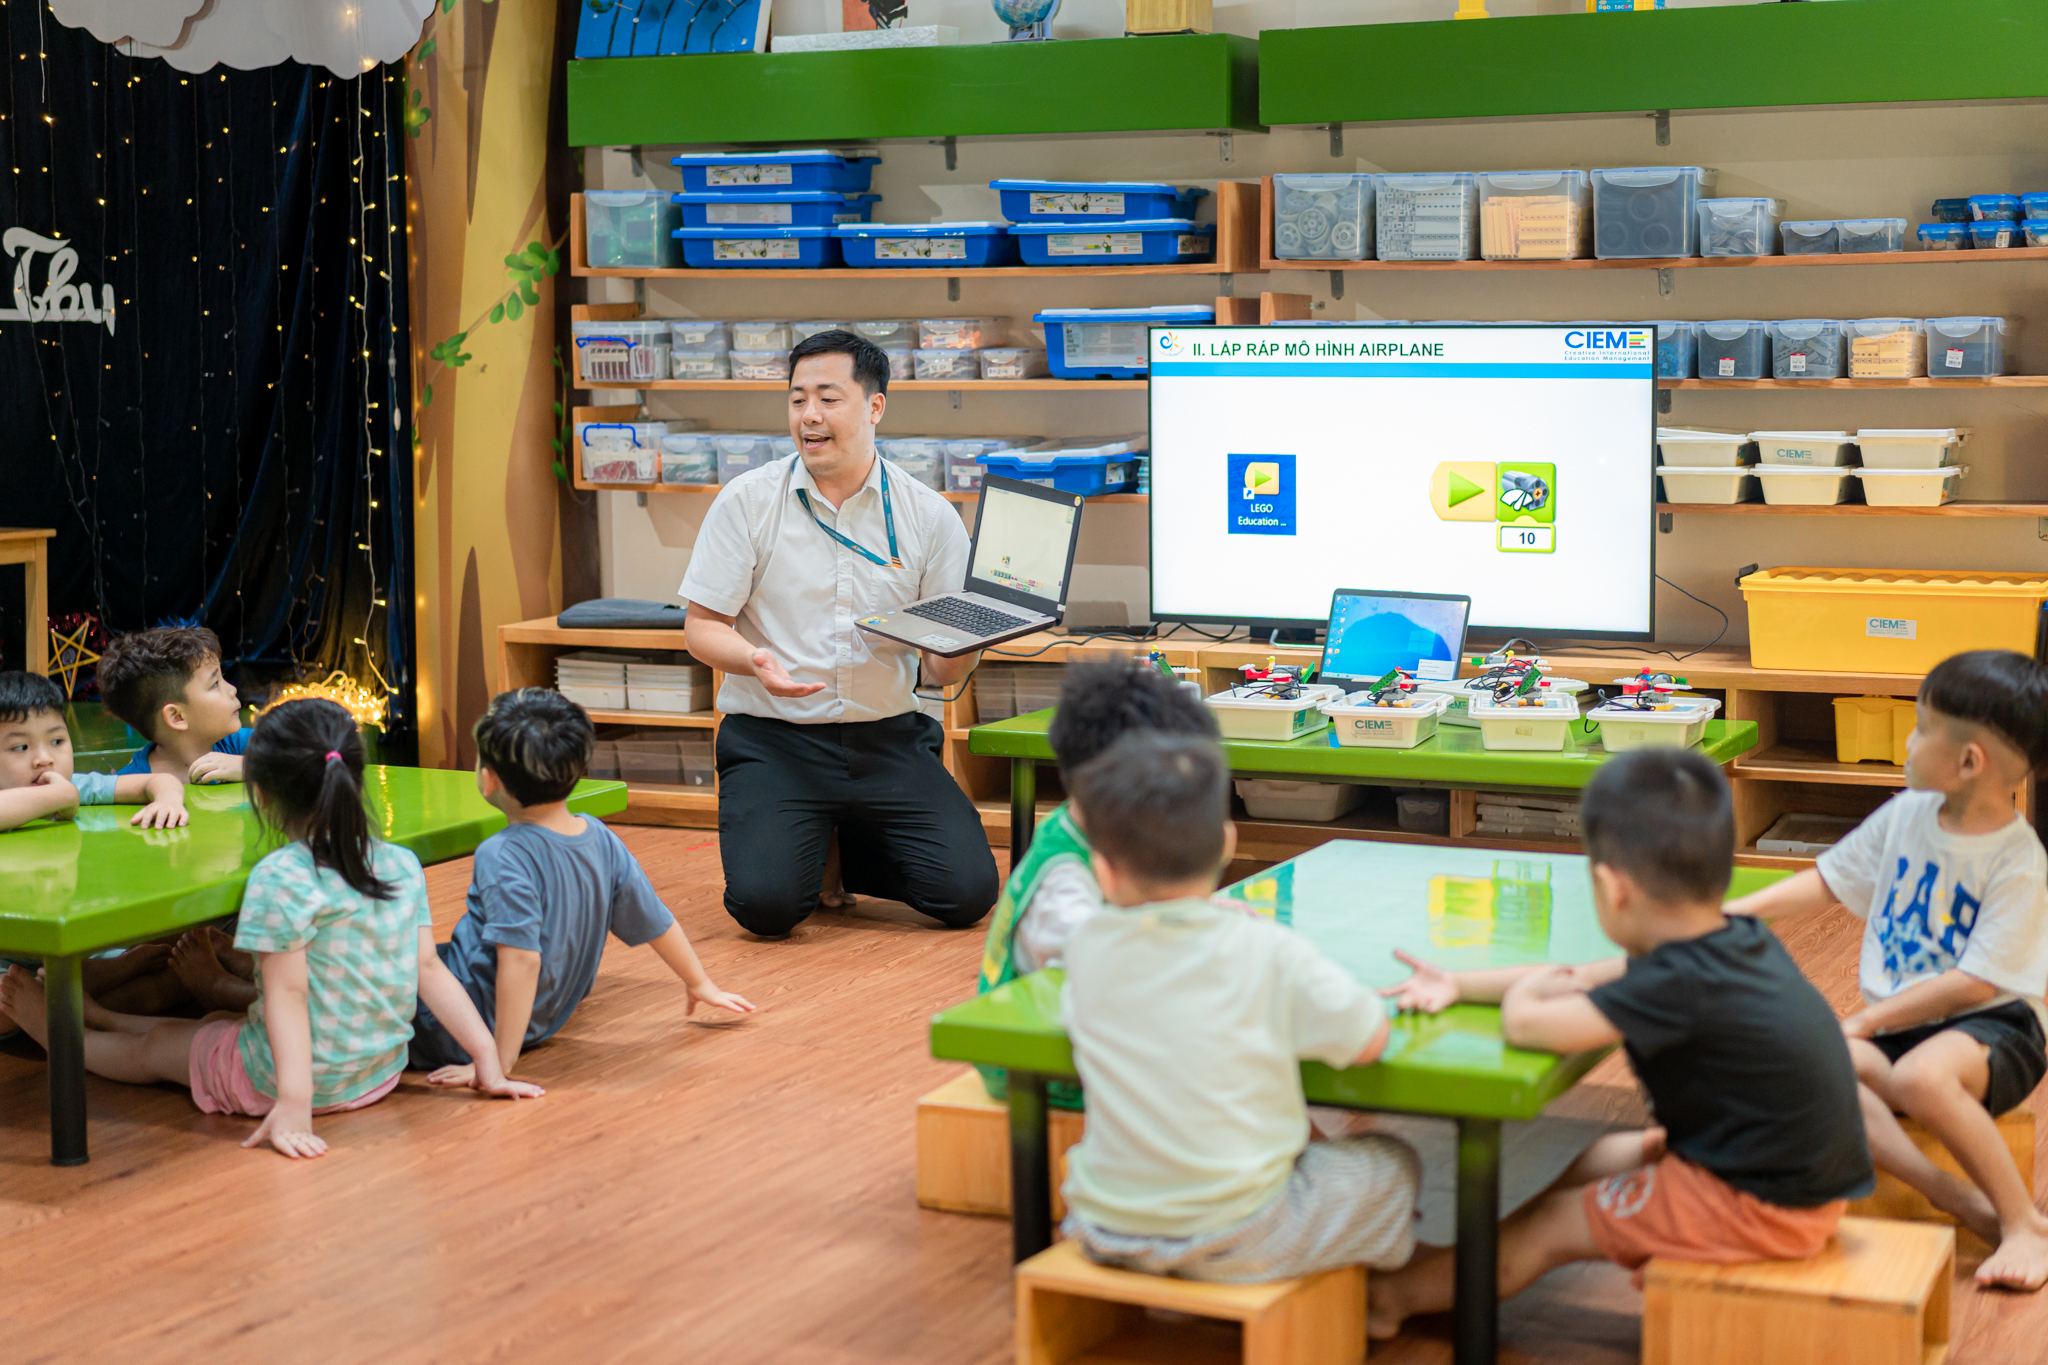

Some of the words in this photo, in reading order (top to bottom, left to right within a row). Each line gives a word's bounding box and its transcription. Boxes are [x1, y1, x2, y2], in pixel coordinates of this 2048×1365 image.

[1193, 343, 1206, 356] II.
[1246, 340, 1280, 356] RÁP
[1284, 340, 1310, 356] MÔ
[1315, 340, 1355, 356] HÌNH
[1359, 343, 1444, 356] AIRPLANE
[1250, 503, 1274, 513] LEGO
[1238, 516, 1279, 526] Education
[1518, 531, 1536, 545] 10
